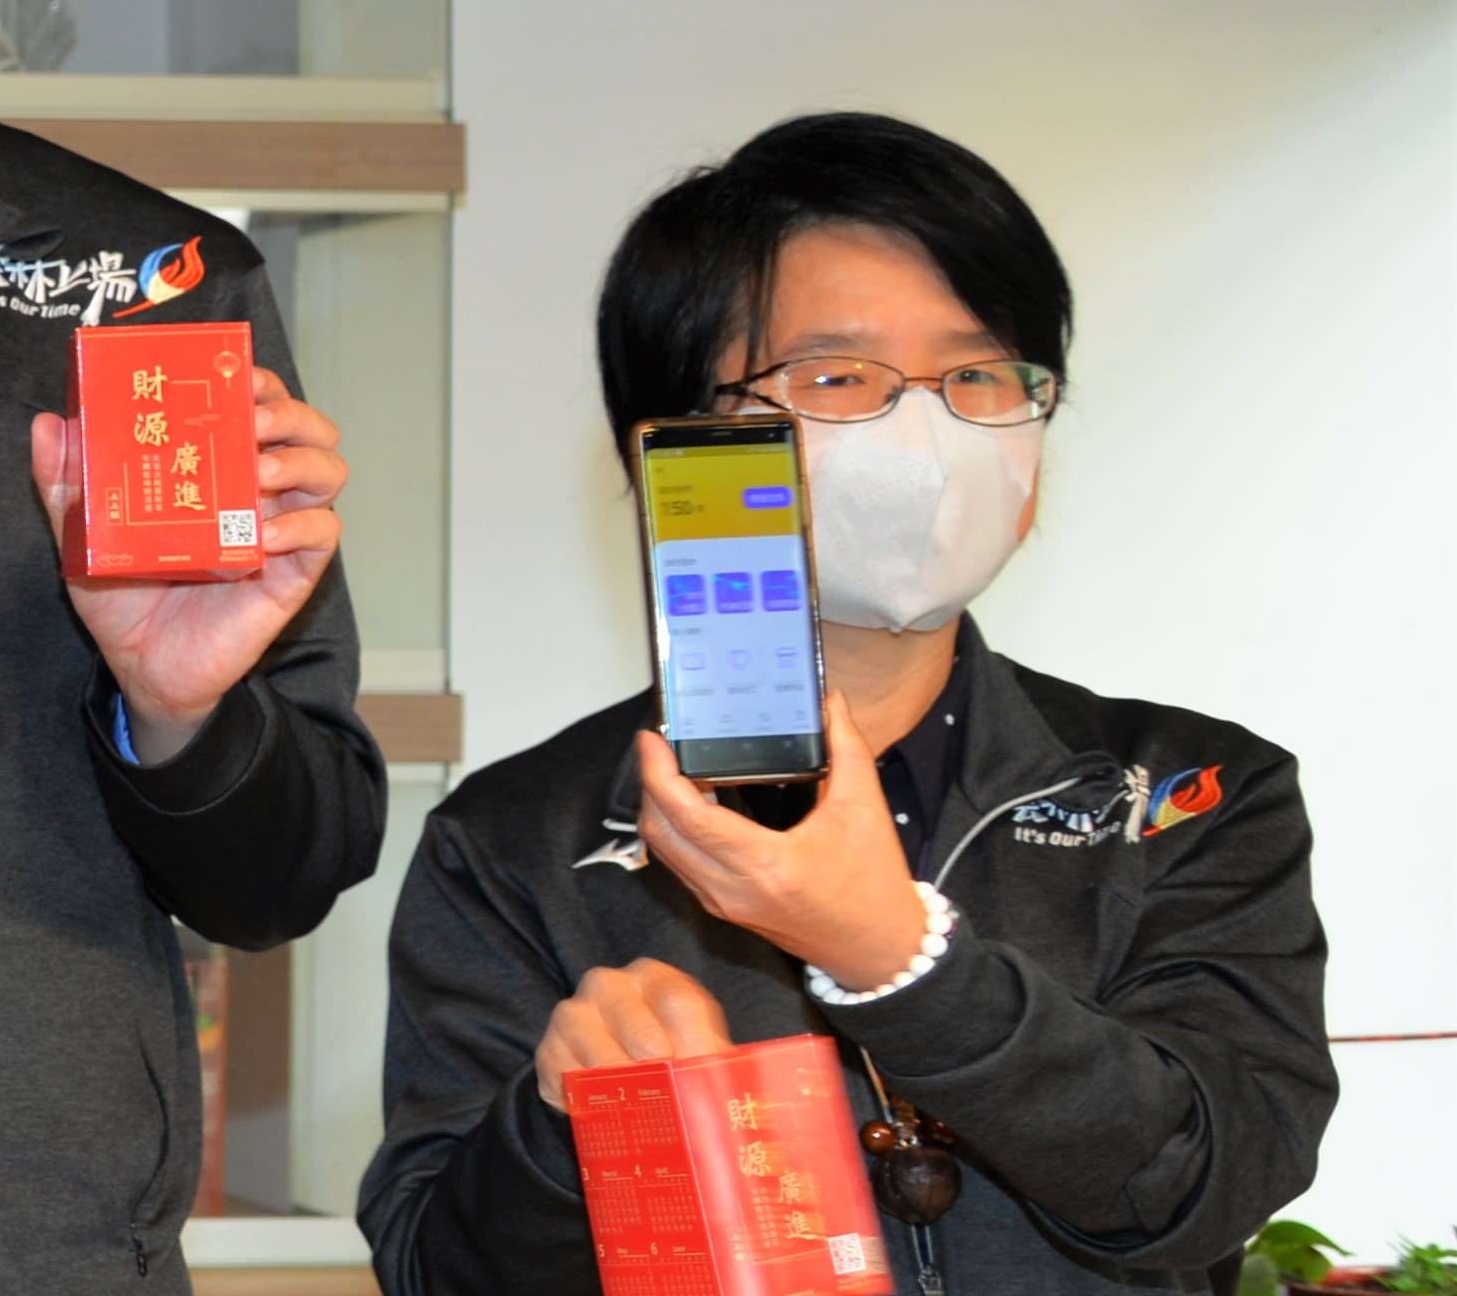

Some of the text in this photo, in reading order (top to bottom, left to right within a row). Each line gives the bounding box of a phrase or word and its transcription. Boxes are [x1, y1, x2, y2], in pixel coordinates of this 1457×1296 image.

[132, 366, 168, 447] 財源
[170, 441, 207, 511] 廣進
[1014, 826, 1047, 845] It's
[1049, 831, 1086, 847] Our
[727, 1092, 771, 1178] 財源
[779, 1170, 829, 1241] 廣進
